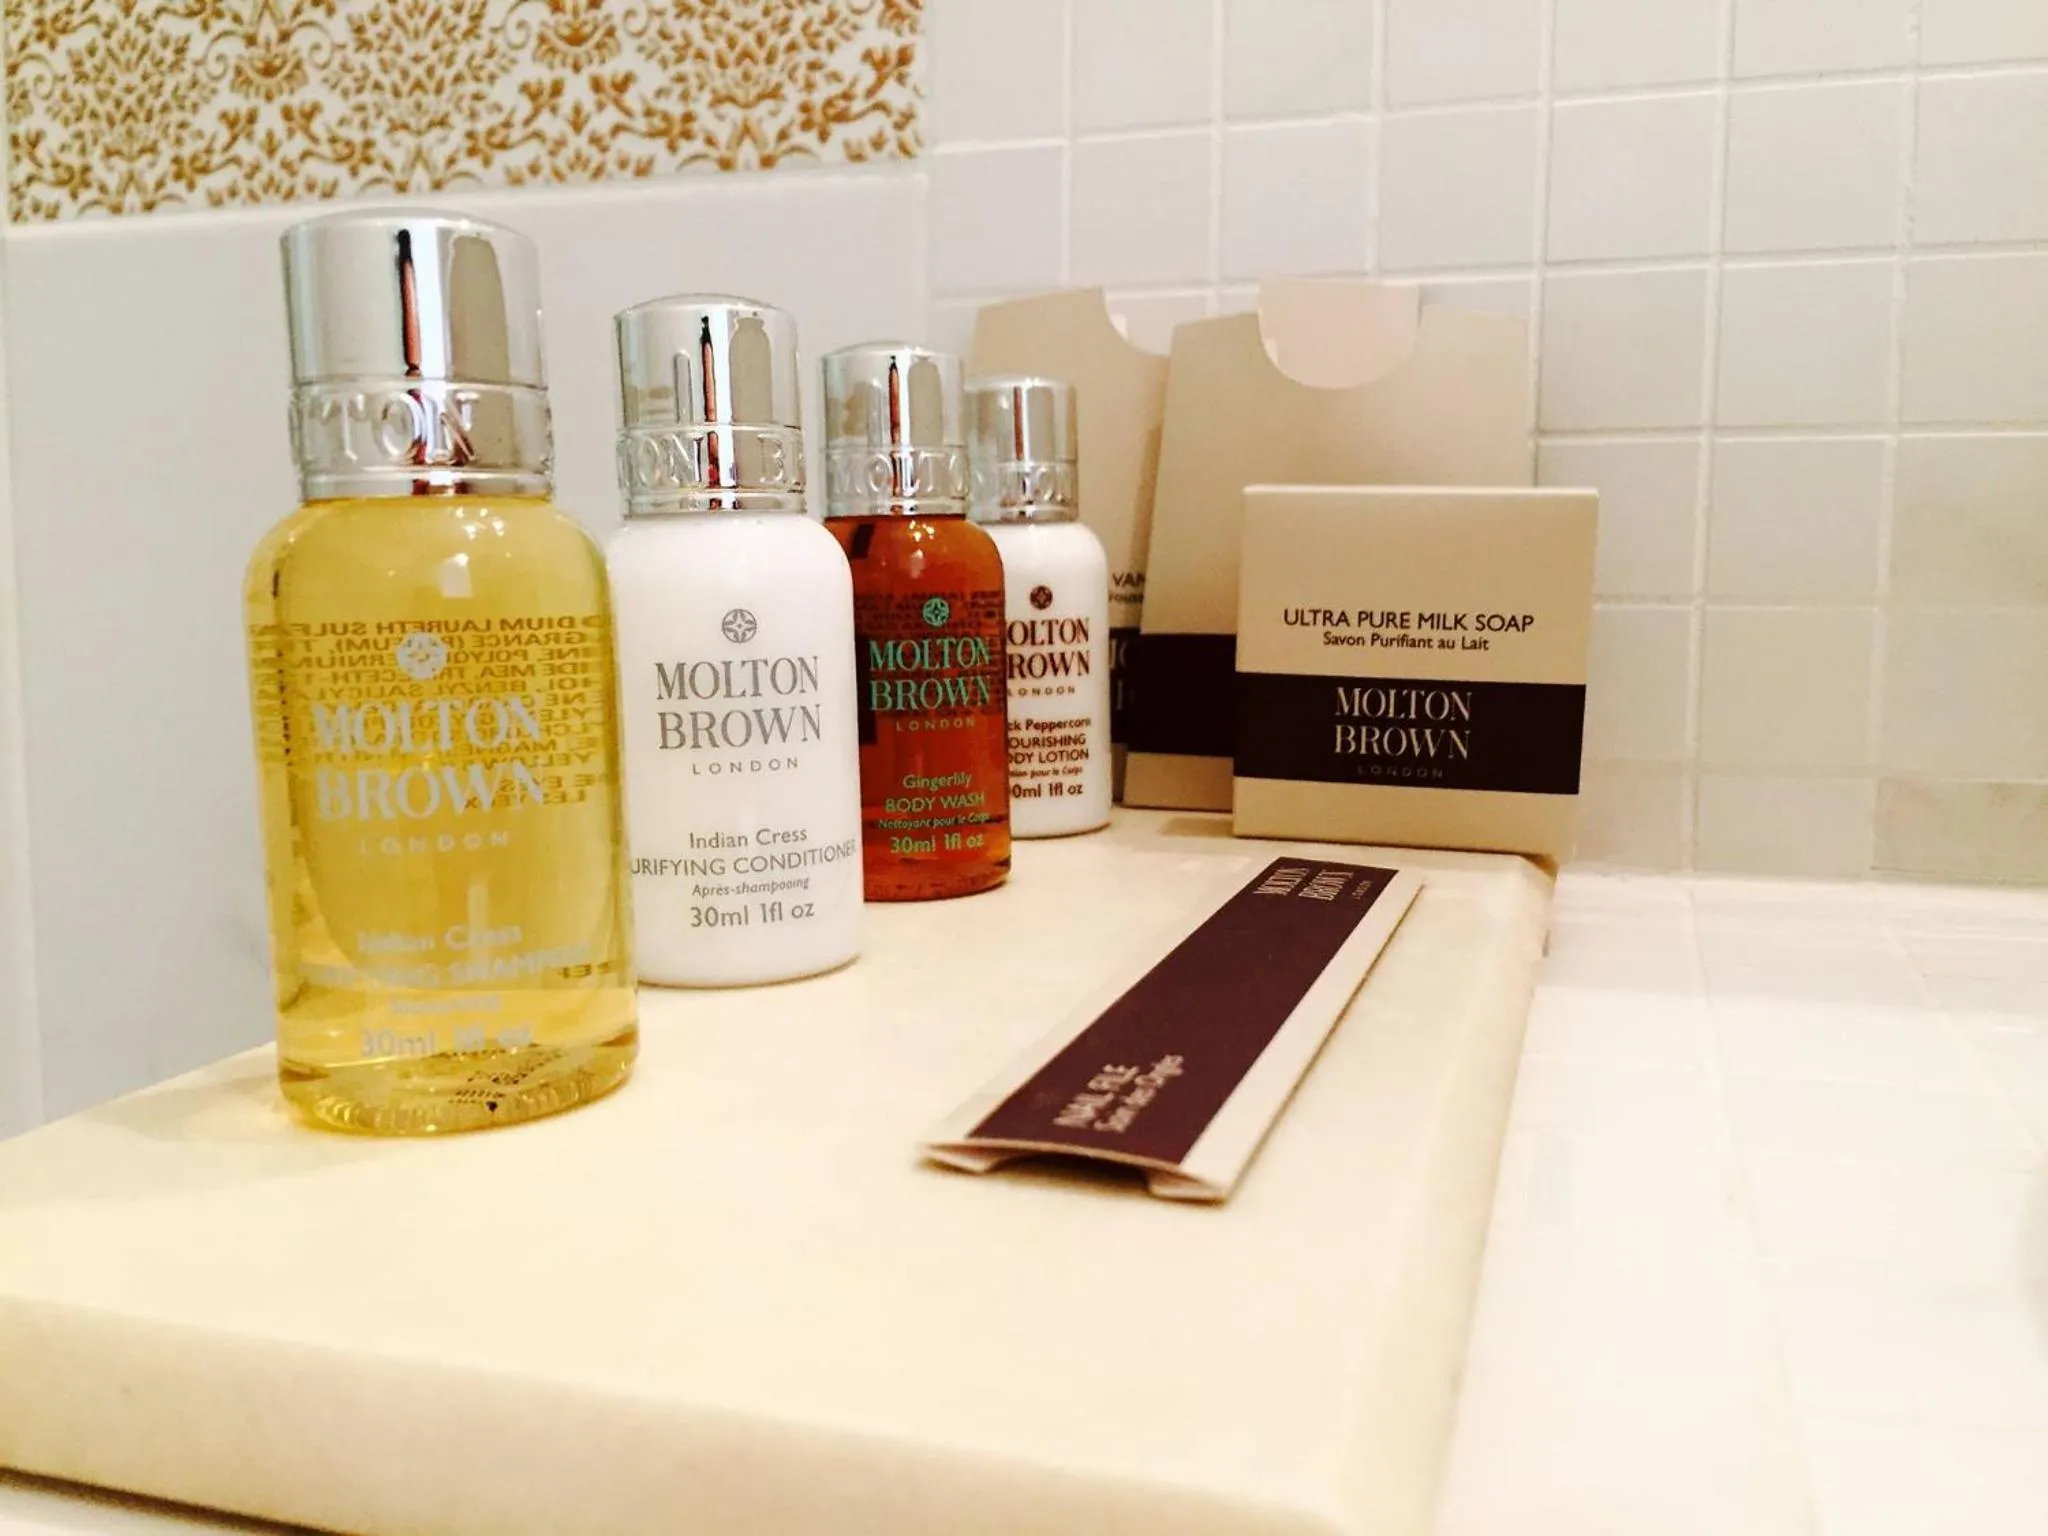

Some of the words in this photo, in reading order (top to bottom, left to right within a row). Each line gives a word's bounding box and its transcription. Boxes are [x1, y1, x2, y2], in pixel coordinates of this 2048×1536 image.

[1283, 608, 1351, 628] ULTRA
[1357, 611, 1411, 630] PURE
[1418, 612, 1469, 632] MILK
[1475, 614, 1535, 633] SOAP
[1006, 617, 1090, 647] OLTON
[1323, 632, 1366, 647] Savon
[1371, 632, 1433, 649] Purifiant
[1438, 637, 1456, 650] au
[1461, 636, 1490, 651] Lait
[869, 636, 991, 671] MOLTON
[1007, 650, 1091, 680] ROWN
[655, 655, 819, 700] MOLTON
[870, 675, 991, 711] BROWN
[1334, 686, 1473, 722] MOLTON
[312, 694, 545, 755] MOLTON
[657, 704, 821, 750] BROWN
[896, 717, 976, 732] LONDON
[1026, 718, 1091, 733] Peppercorn
[1334, 724, 1472, 760] BROWN
[692, 758, 799, 775] LONDON
[1039, 748, 1089, 763] LOTION
[903, 771, 973, 793] Gingerlily
[1357, 765, 1443, 779] LONDON
[316, 761, 545, 821] BROWN
[1067, 784, 1084, 795] oz
[884, 797, 936, 813] BODY
[940, 791, 986, 809] WASH
[690, 832, 748, 849] Indian
[756, 828, 808, 846] Cress
[889, 834, 937, 854] 30ml
[966, 833, 984, 848] oz
[630, 857, 727, 877] URIFYING
[691, 877, 810, 898] Après-shampooing
[690, 905, 749, 928] 30ml
[760, 902, 784, 924] 1fl
[791, 902, 815, 920] oz
